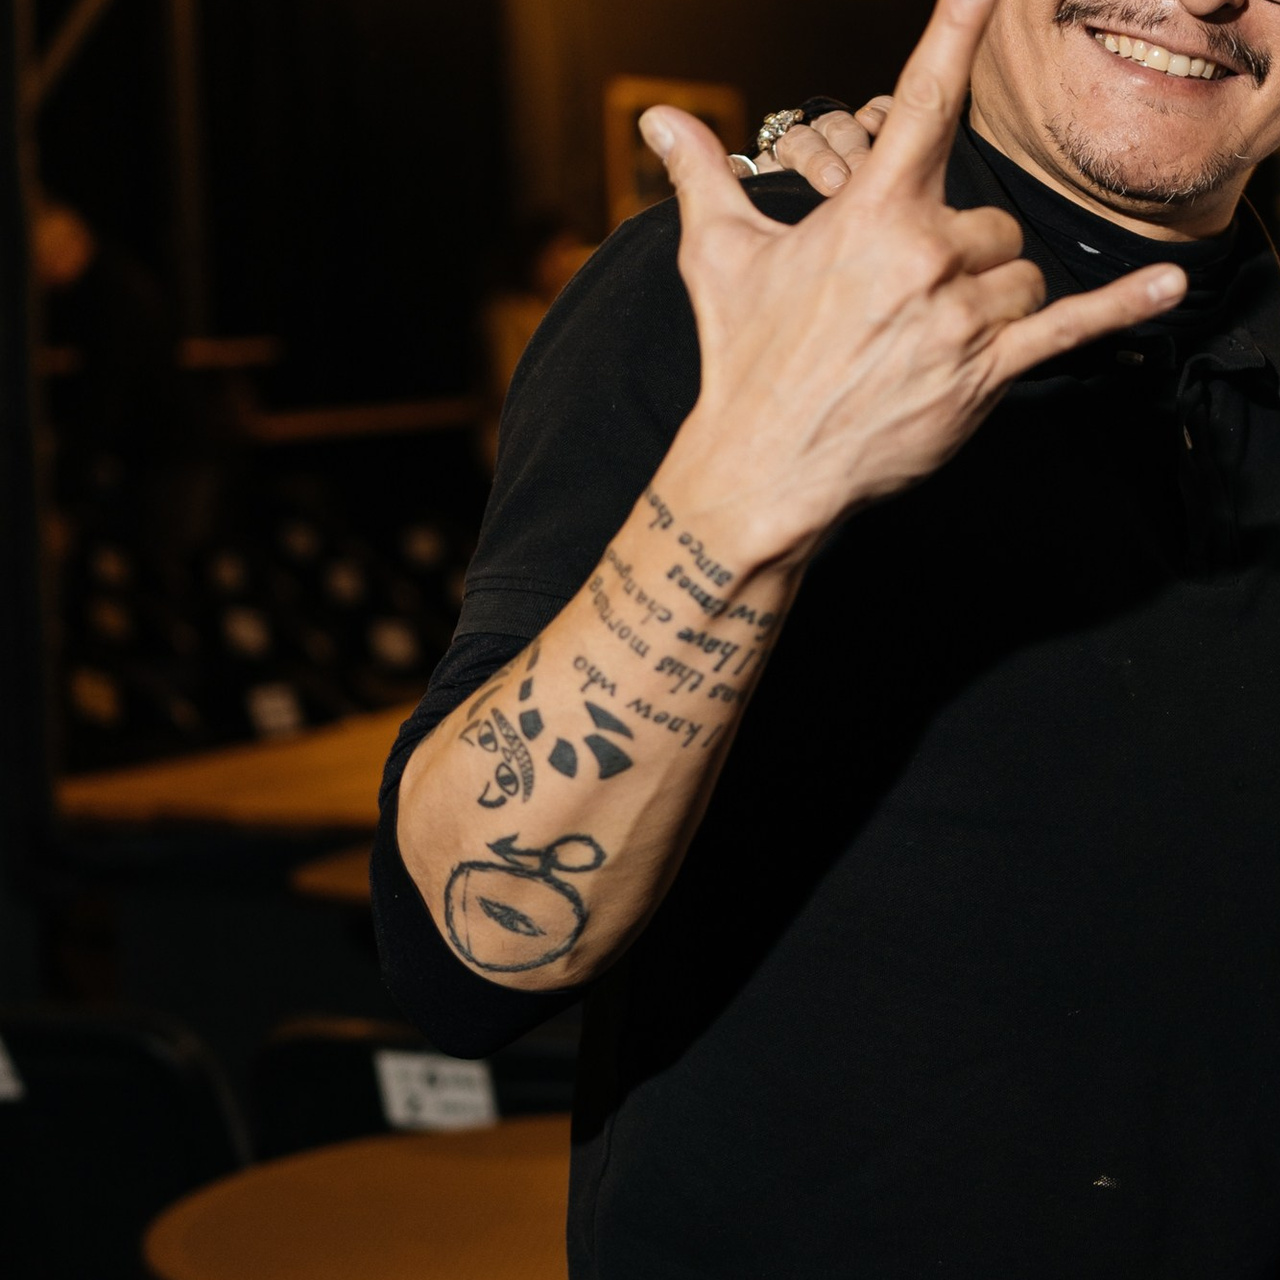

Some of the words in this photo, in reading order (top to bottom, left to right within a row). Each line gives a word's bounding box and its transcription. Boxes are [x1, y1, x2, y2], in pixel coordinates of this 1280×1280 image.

[677, 626, 740, 672] have
[573, 655, 617, 697] who
[654, 656, 705, 693] this
[627, 697, 703, 748] knew
